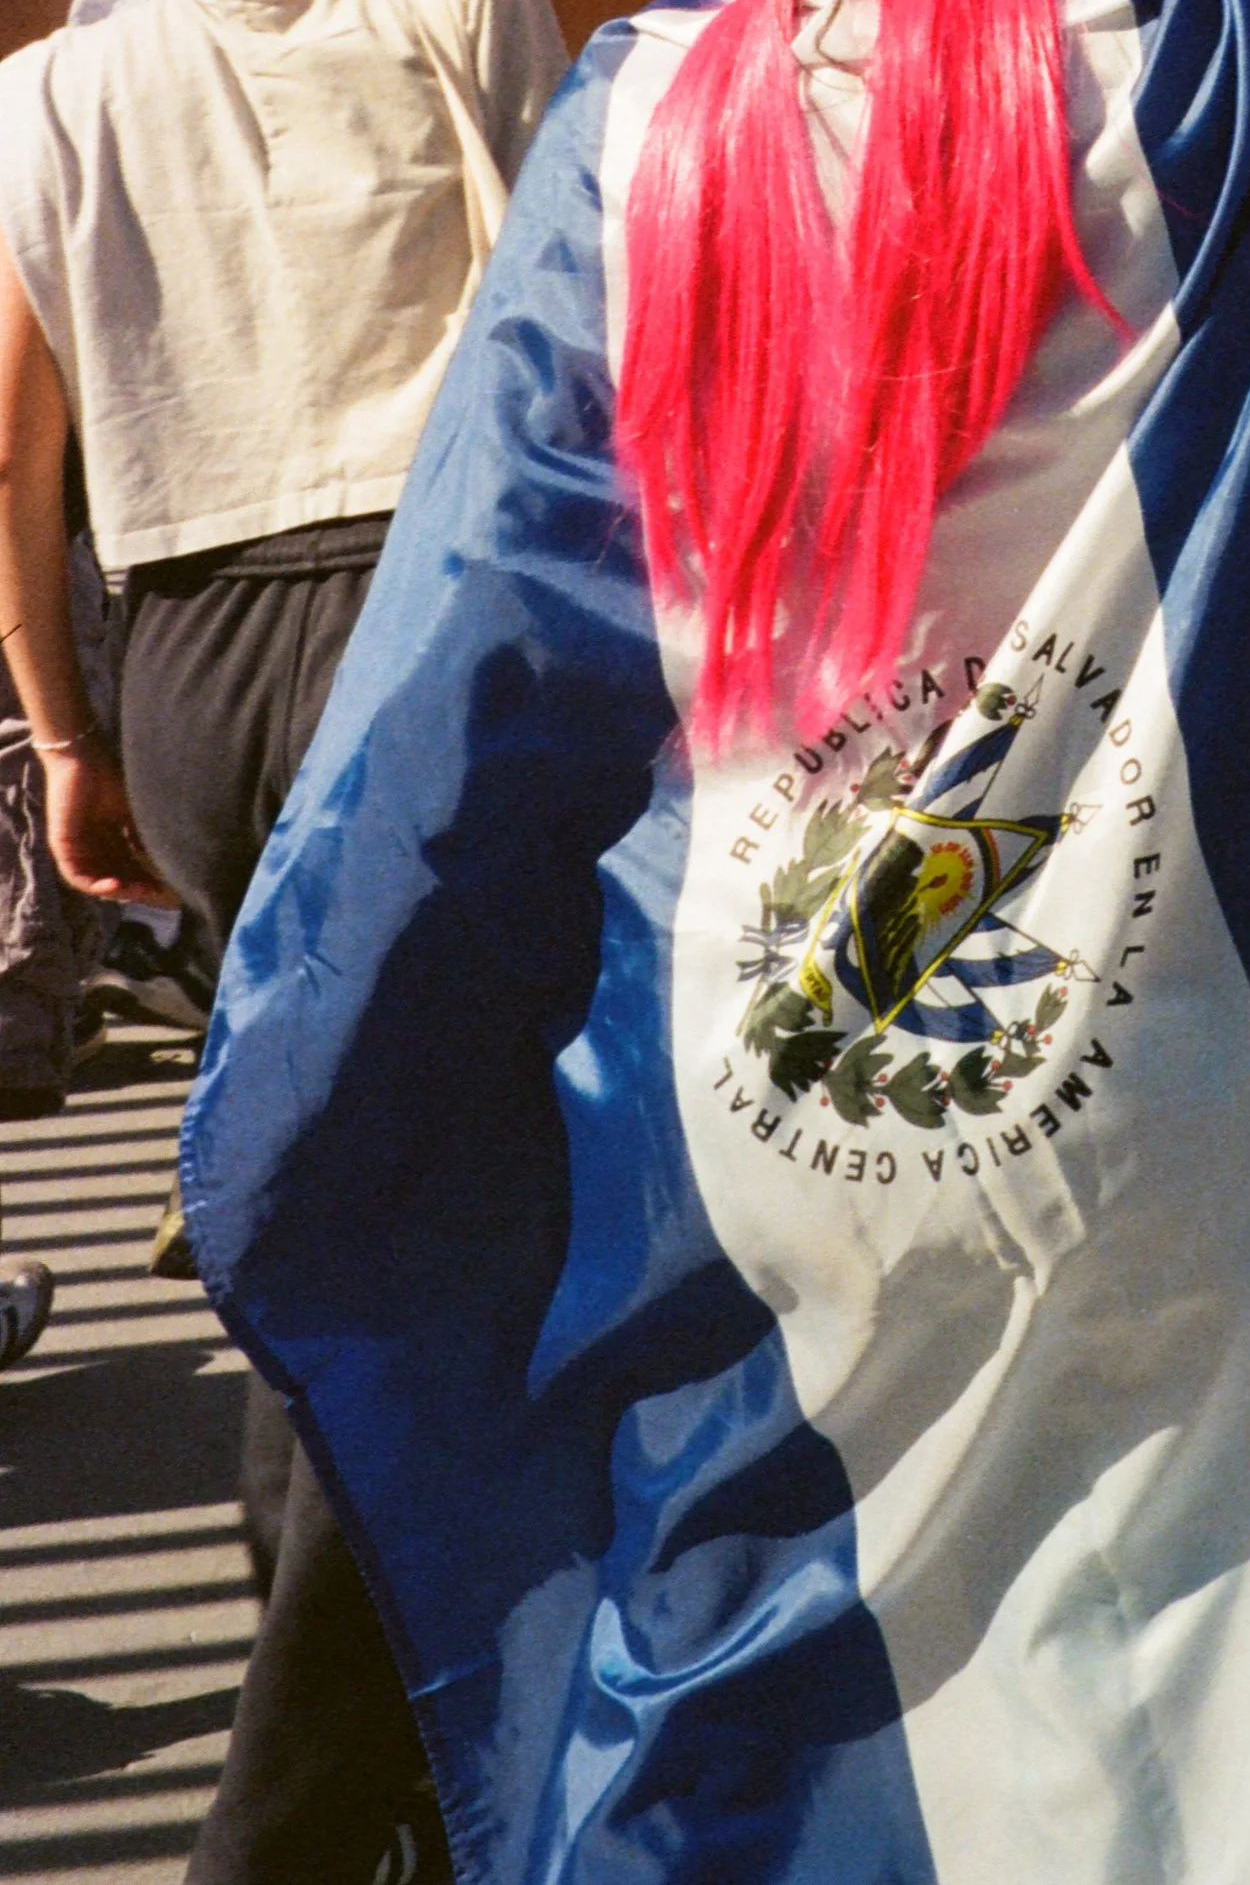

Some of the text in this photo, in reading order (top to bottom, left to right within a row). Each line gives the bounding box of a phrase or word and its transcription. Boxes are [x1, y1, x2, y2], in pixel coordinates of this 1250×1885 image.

[1010, 620, 1157, 826] SALVADOR
[1132, 852, 1161, 918] EN
[1105, 946, 1145, 1008] LA
[713, 1056, 897, 1184] CENTRAL
[922, 1038, 1115, 1183] AMERICA
